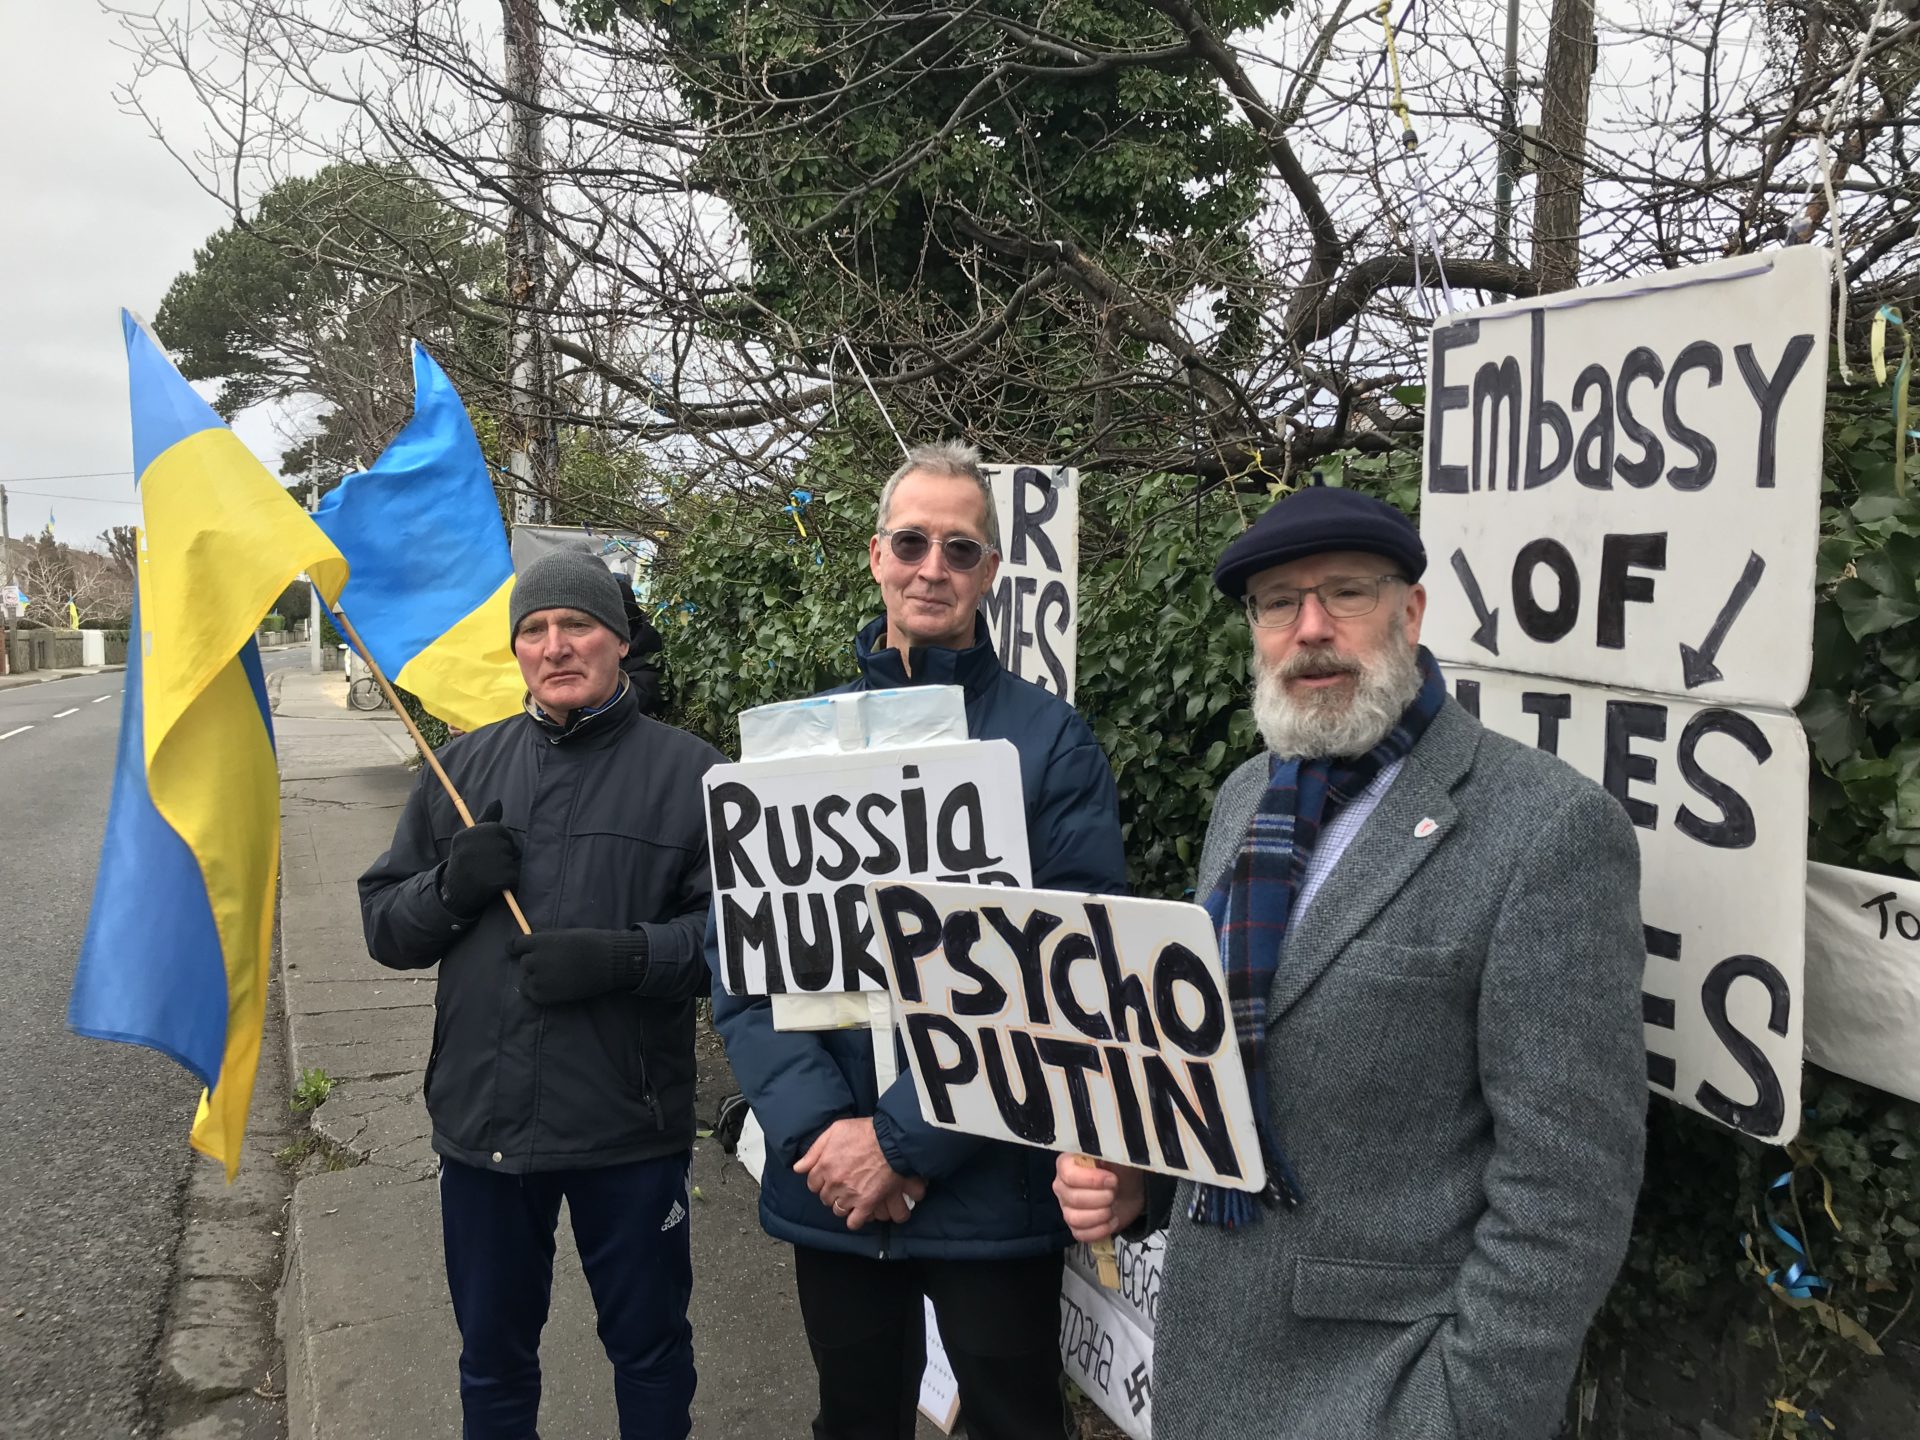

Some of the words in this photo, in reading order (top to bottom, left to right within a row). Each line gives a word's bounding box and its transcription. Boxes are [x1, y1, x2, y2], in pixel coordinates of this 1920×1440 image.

[1511, 531, 1668, 650] OF
[905, 1013, 1243, 1179] PUTIN
[1059, 1292, 1114, 1395] трана
